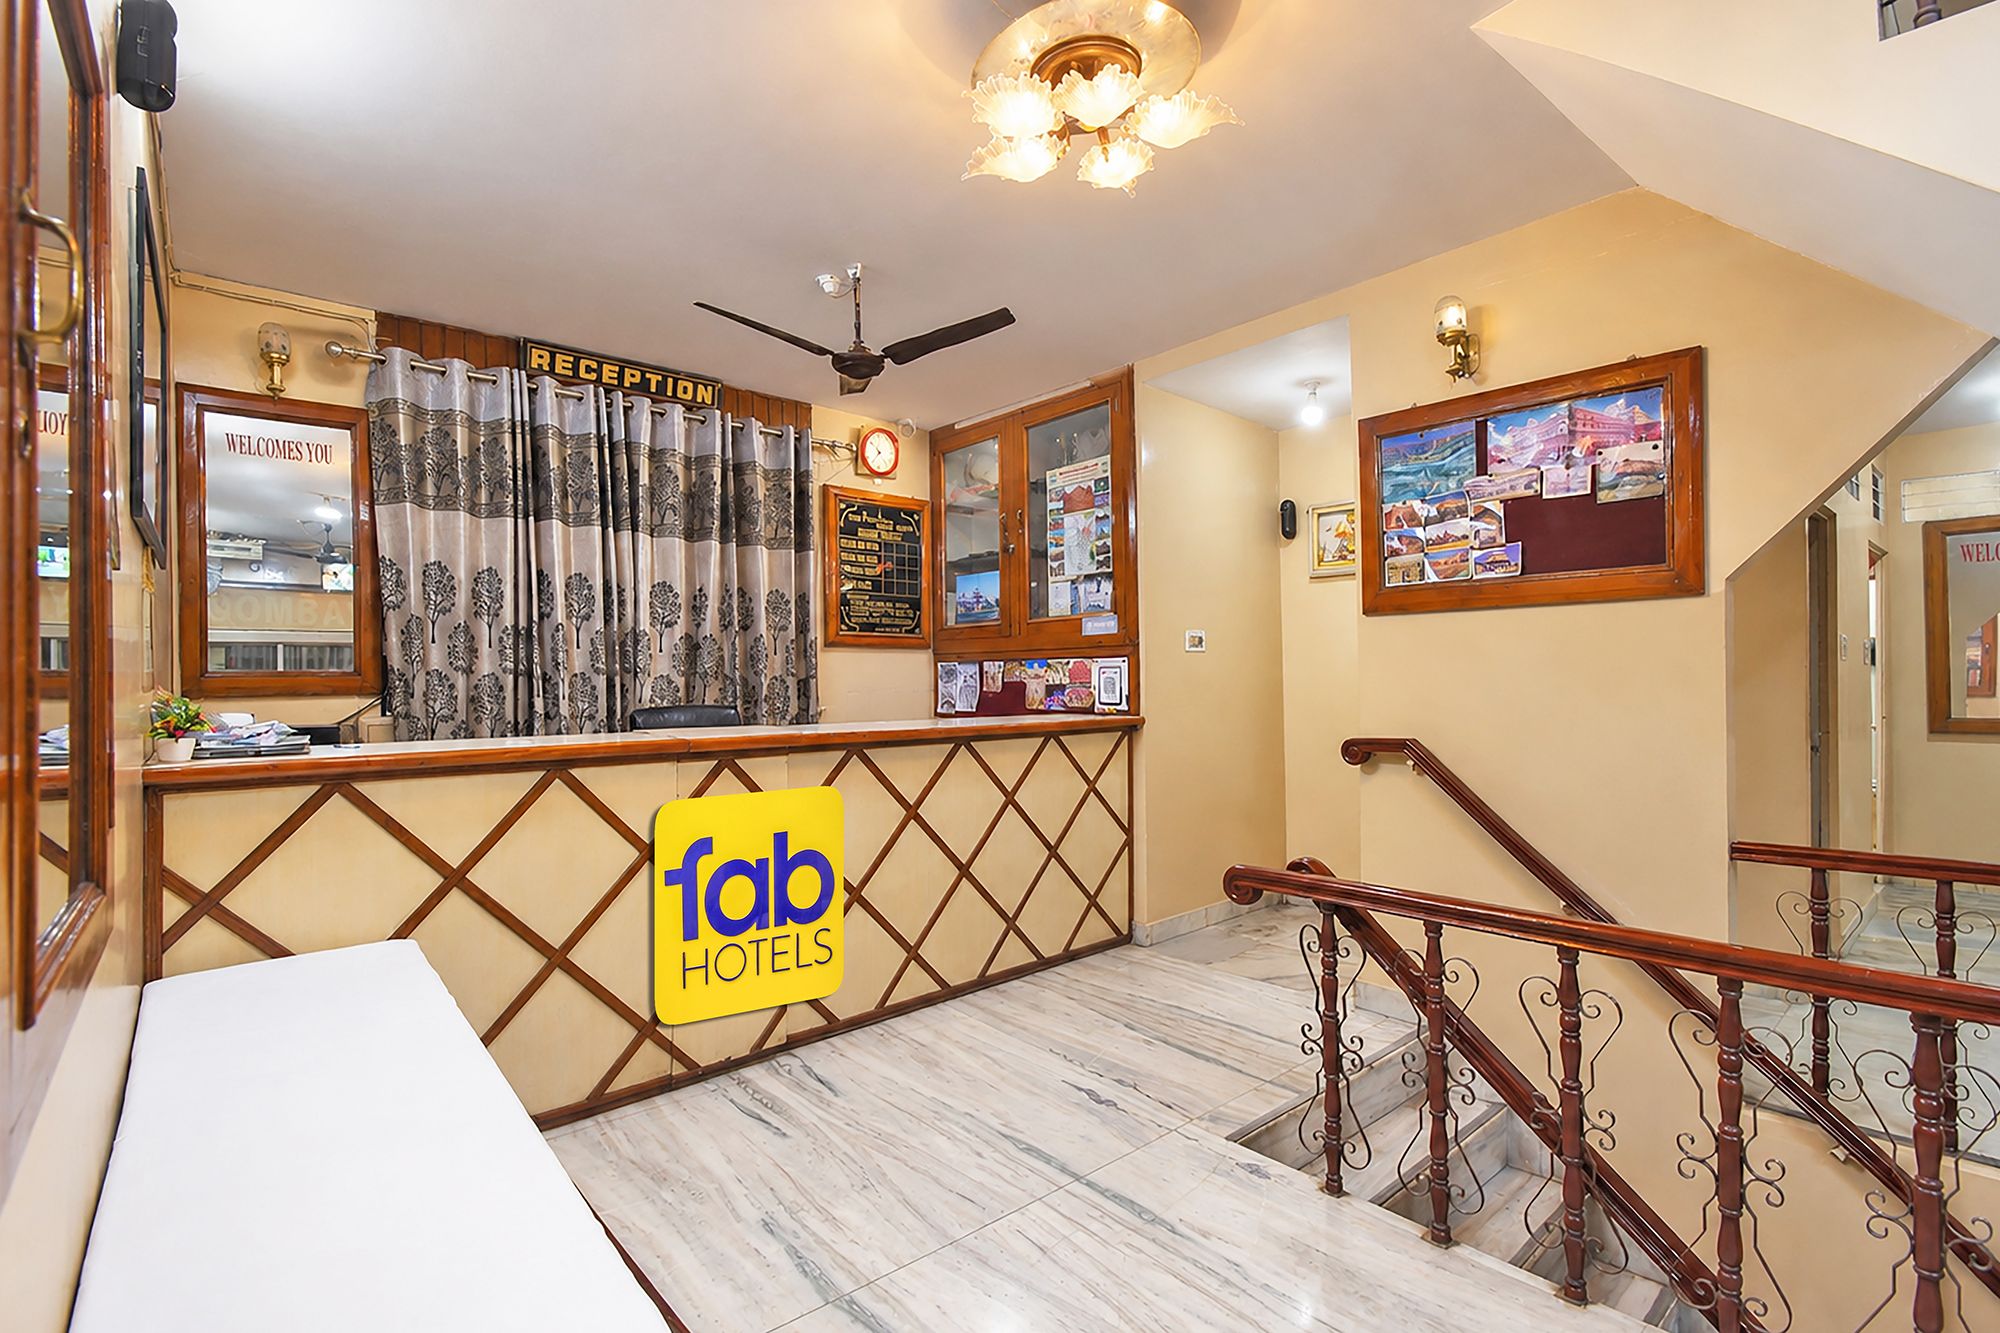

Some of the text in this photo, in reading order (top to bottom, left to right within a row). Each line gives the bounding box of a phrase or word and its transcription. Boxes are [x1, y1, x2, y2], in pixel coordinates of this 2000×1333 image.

[529, 347, 713, 405] RECEPTION
[225, 432, 333, 465] WELCOMES YOU
[664, 831, 835, 942] fab
[682, 927, 834, 990] HOTELS
